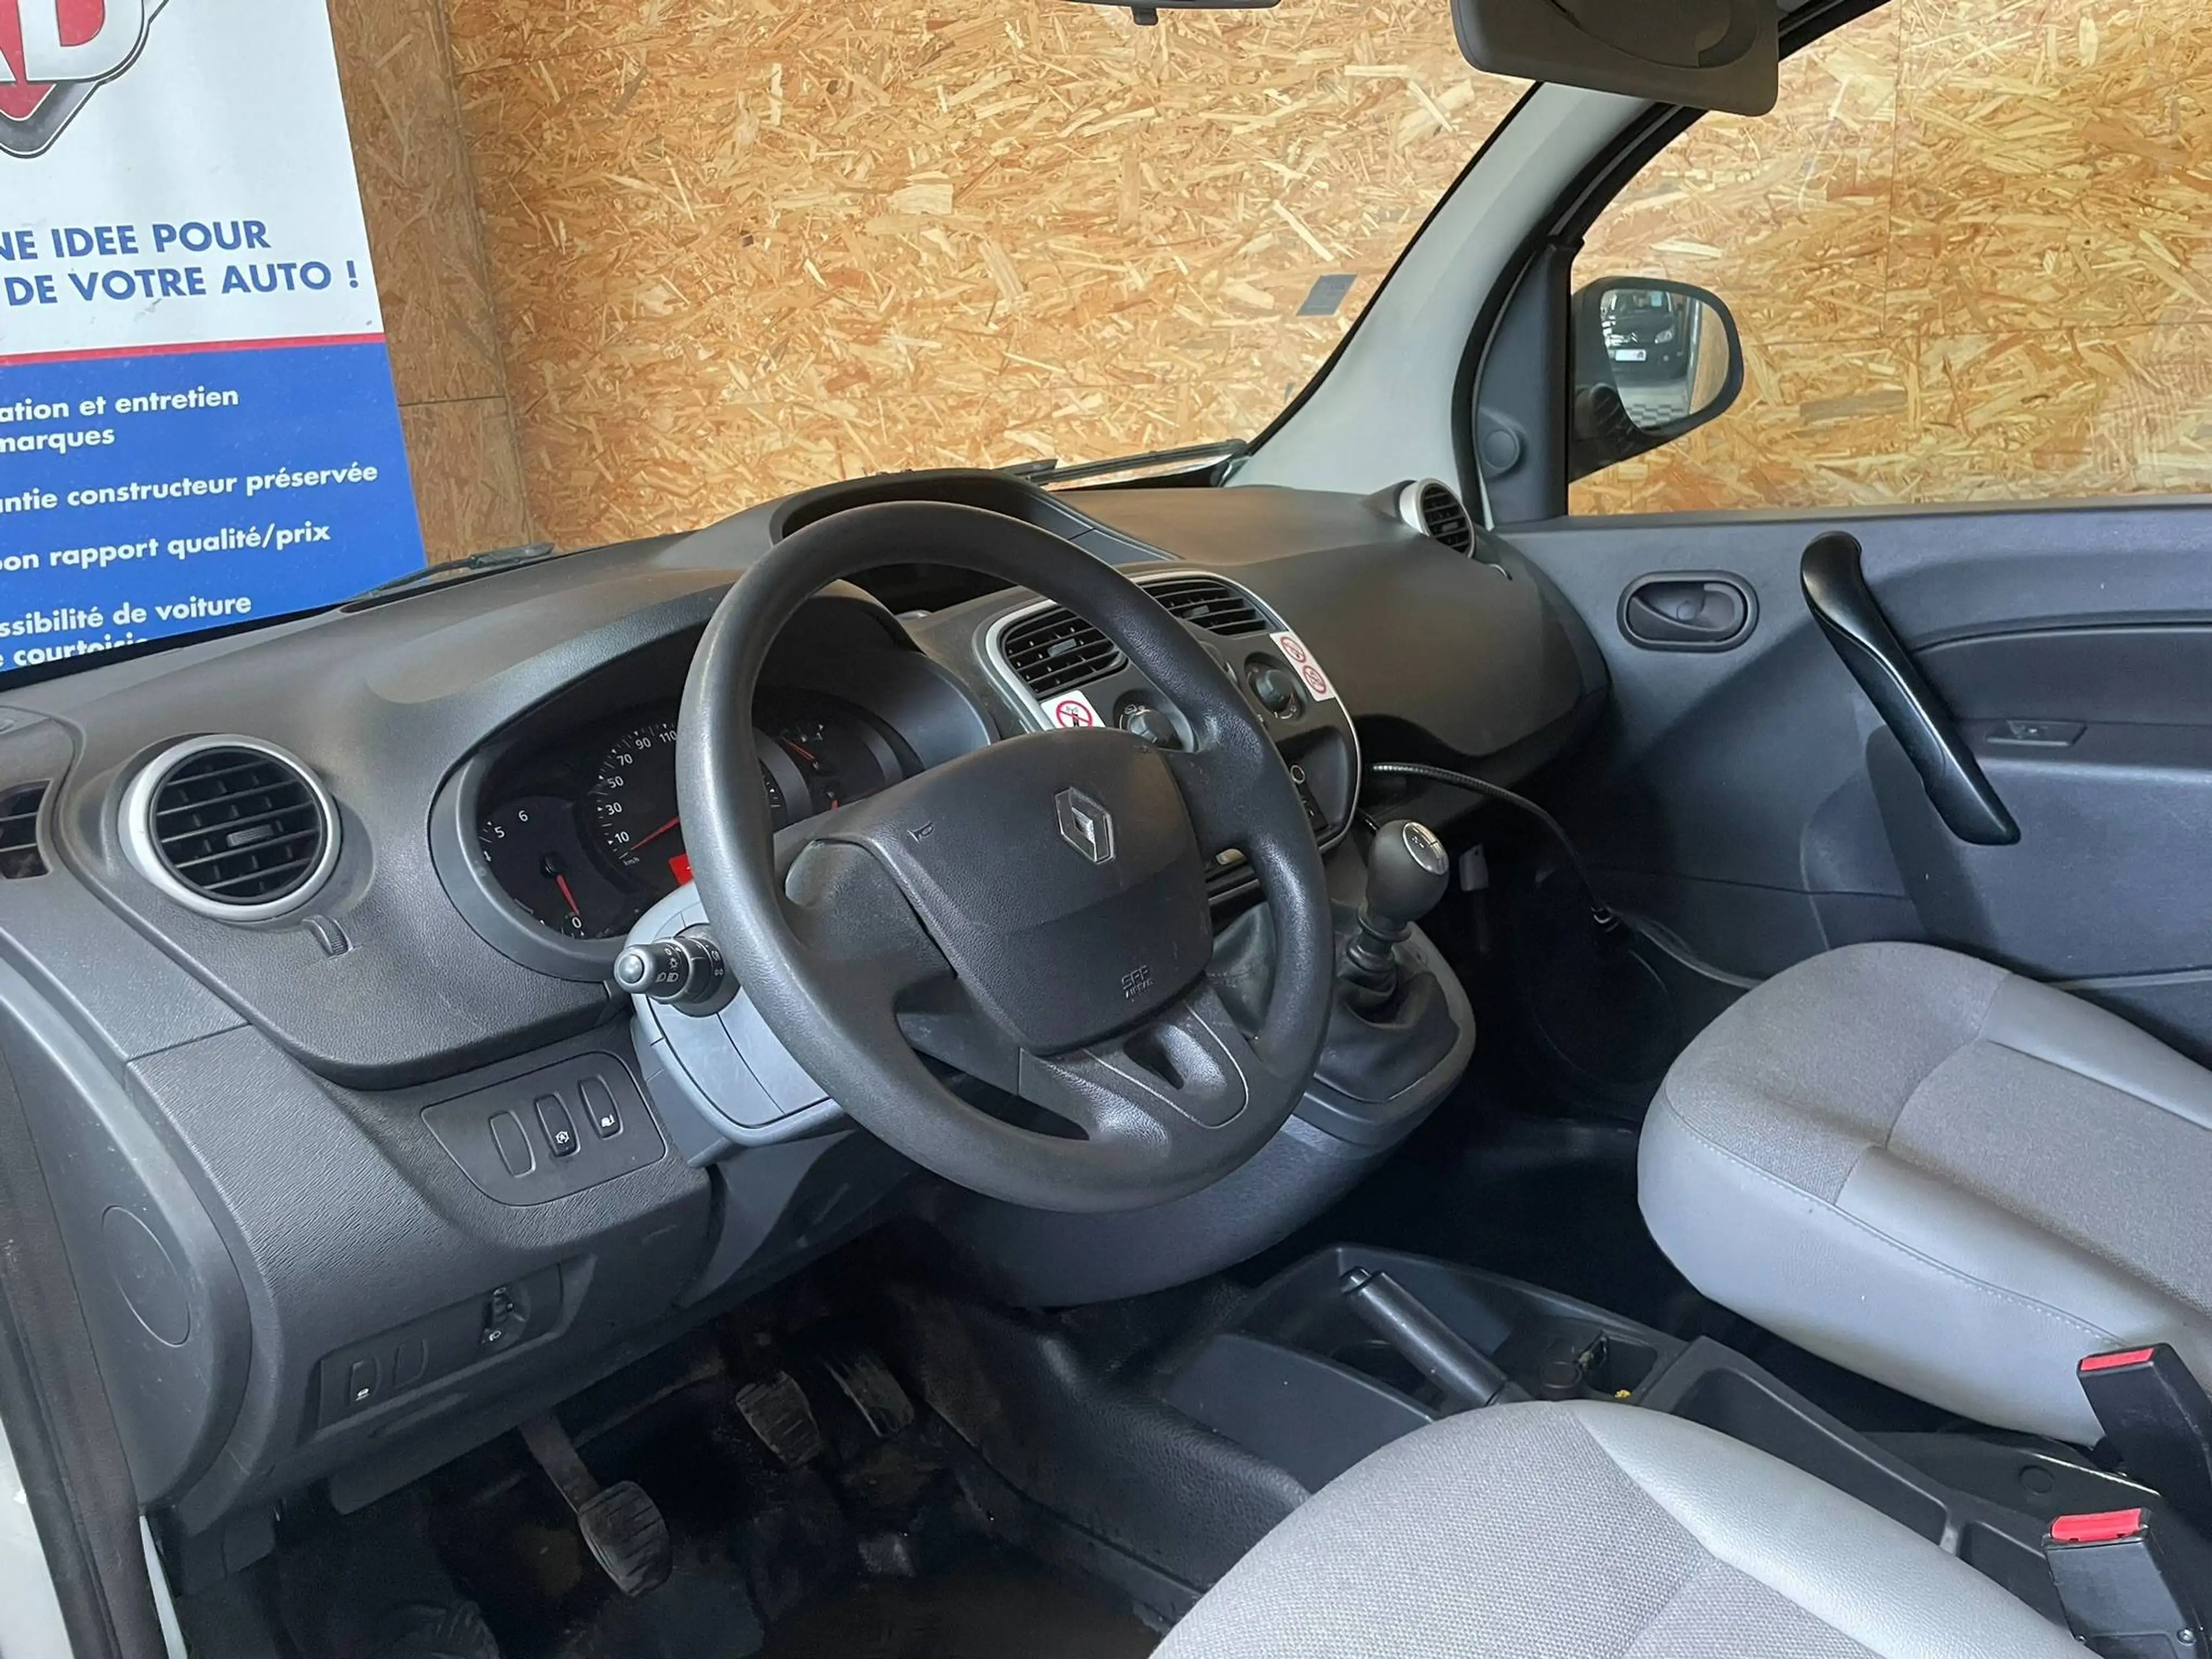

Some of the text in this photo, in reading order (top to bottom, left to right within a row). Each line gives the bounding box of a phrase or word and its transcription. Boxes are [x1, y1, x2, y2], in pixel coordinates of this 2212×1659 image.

[51, 225, 139, 258] IDEE
[152, 220, 271, 252] POUR
[4, 275, 58, 306] DE
[68, 268, 206, 301] VOTRE
[222, 262, 331, 294] AUTO
[79, 396, 106, 416] et
[115, 385, 238, 413] entretien
[0, 461, 377, 513] ntie constructeur préservée
[0, 521, 331, 571] on rapport qualité/prix
[113, 601, 147, 625] de
[155, 596, 252, 620] voiture
[659, 730, 677, 743] 110
[635, 737, 652, 750] 90
[616, 753, 633, 766] 70
[607, 776, 624, 789] 50
[605, 802, 623, 815] 30
[518, 809, 528, 822] 6
[494, 826, 505, 838] 5
[614, 831, 630, 843] 10
[571, 916, 582, 929] 0
